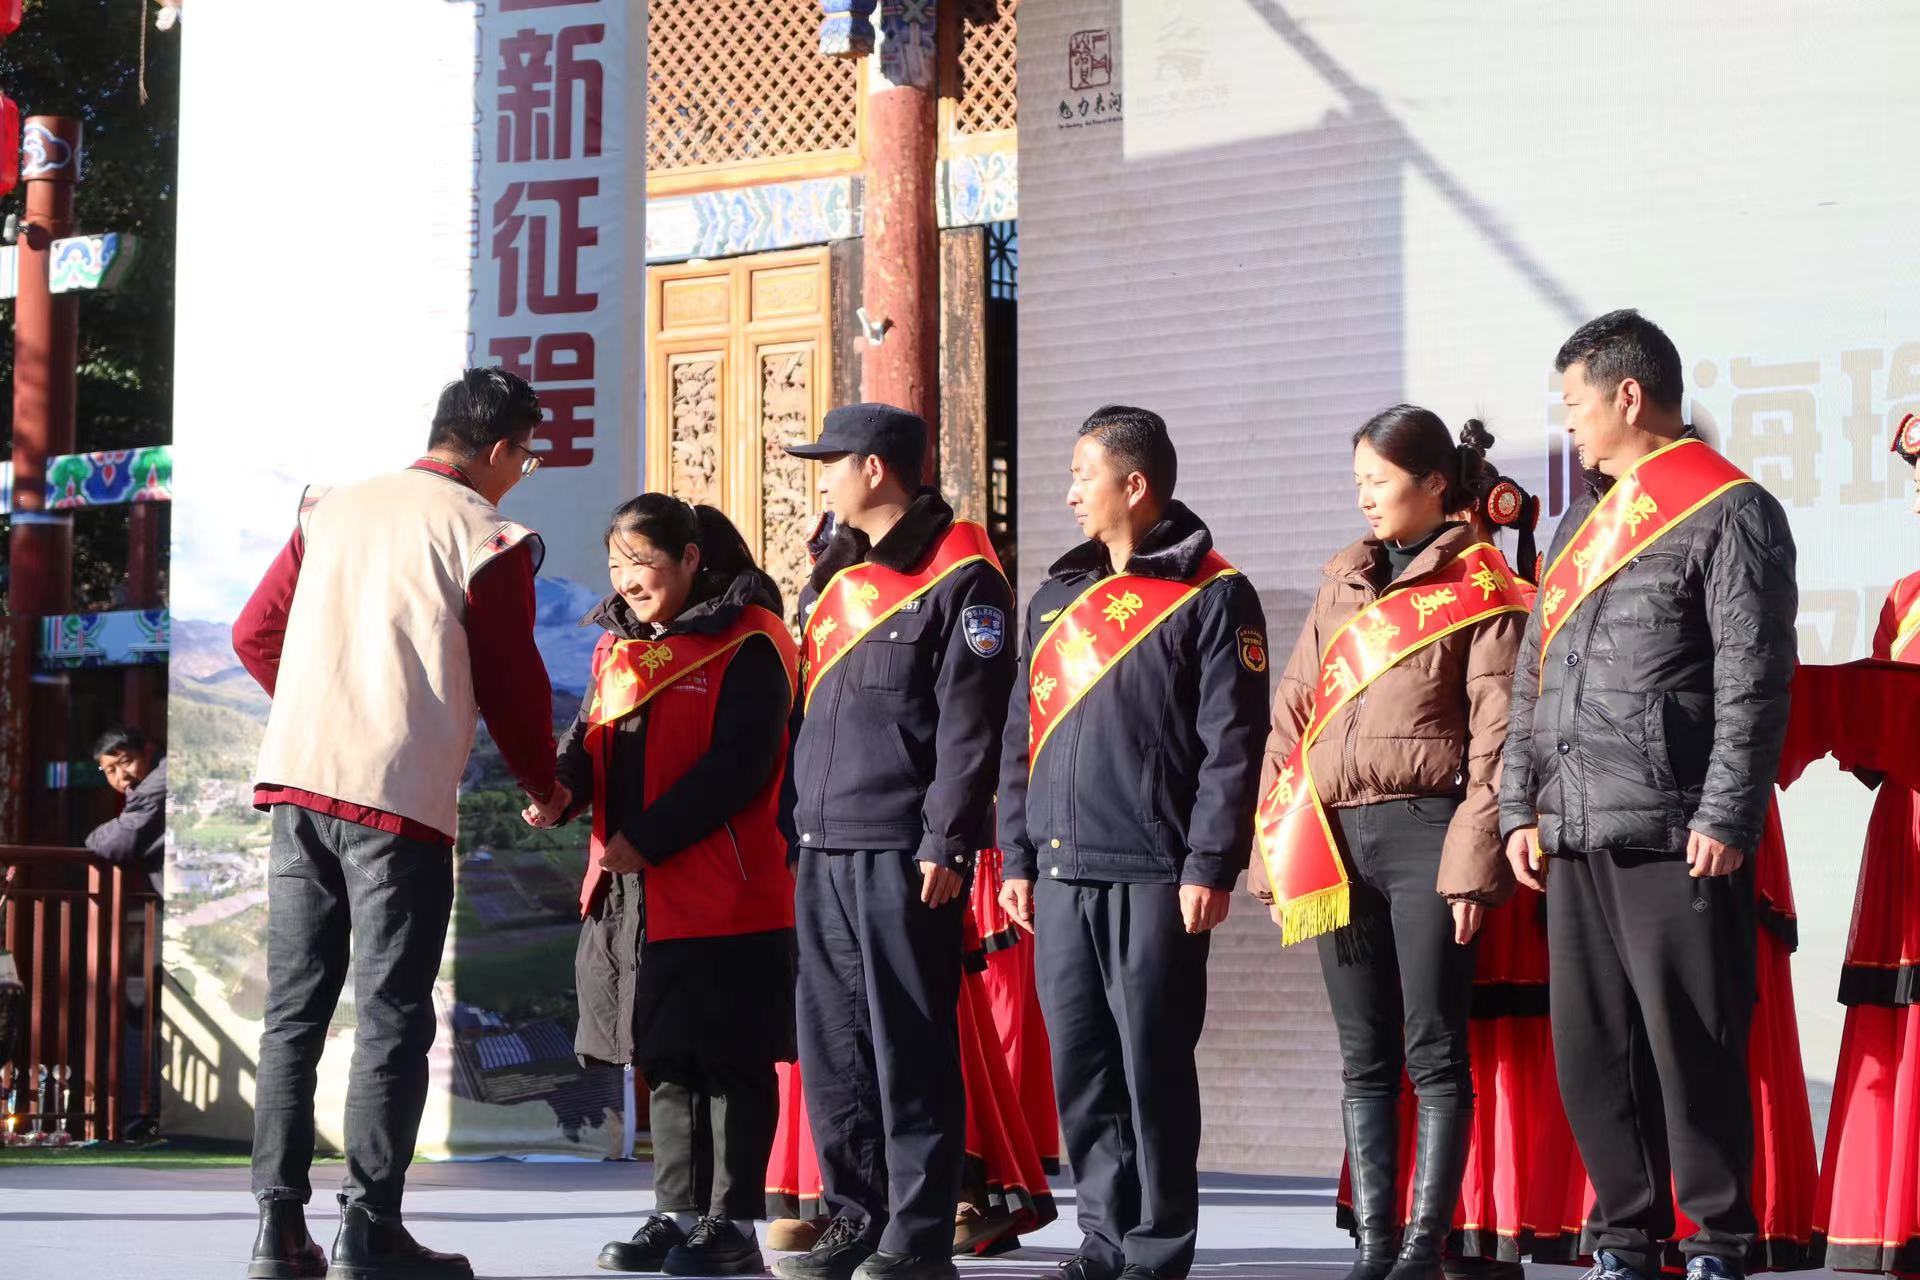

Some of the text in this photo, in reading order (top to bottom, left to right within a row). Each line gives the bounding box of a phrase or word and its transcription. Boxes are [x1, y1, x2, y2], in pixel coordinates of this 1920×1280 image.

[489, 0, 606, 468] 新征程
[1029, 589, 1144, 746] 最美逆
